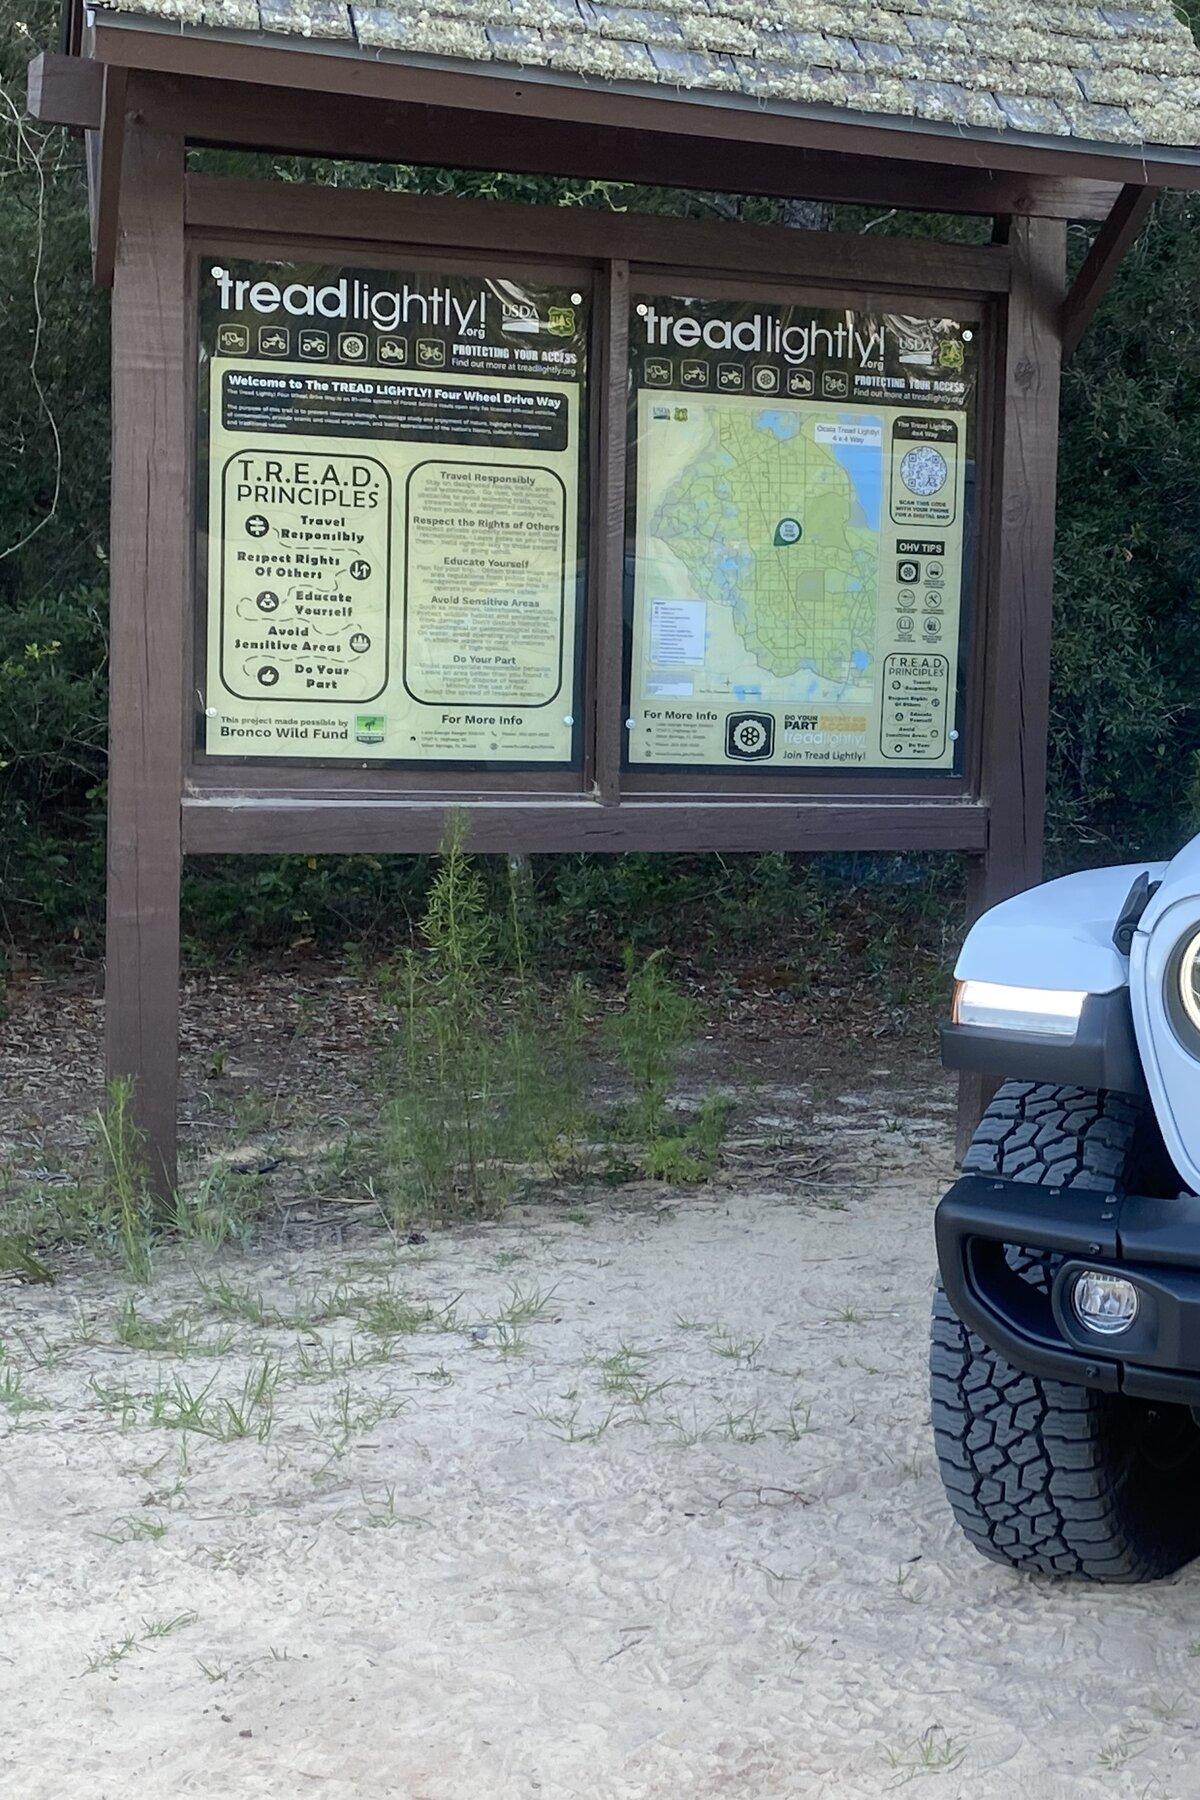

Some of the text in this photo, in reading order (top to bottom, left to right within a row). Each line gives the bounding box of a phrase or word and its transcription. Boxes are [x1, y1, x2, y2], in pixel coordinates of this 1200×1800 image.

[502, 304, 539, 318] USDA
[453, 344, 577, 364] PROTECTING YOUR ACCESS
[452, 358, 470, 367] Find
[471, 360, 485, 368] out
[486, 362, 507, 370] more
[508, 363, 516, 371] at
[854, 375, 965, 393] PROTECTING YOUR ACCESS
[228, 375, 561, 409] Welcome to The TREAD LIGHTLY! Four Wheel Drive Way
[853, 387, 869, 396] Find
[870, 389, 882, 397] out
[884, 391, 902, 399] more
[903, 392, 911, 400] at
[238, 459, 380, 488] T.R.E.A.D.
[440, 471, 536, 486] Travel Responsibly
[237, 484, 379, 509] PRINCIPLES
[300, 515, 346, 527] Travel
[413, 516, 560, 532] Respect the Rights of Others
[281, 528, 365, 544] Responsibly
[899, 543, 942, 553] OHV TIPS
[237, 551, 340, 567] Respect Rights
[443, 557, 529, 569] Educate Yourself
[255, 566, 322, 580] Of Others
[296, 590, 352, 603] Educate
[431, 595, 540, 608] Avoid Sensitive Areas
[295, 605, 353, 617] Yourself
[267, 626, 309, 637] Avoid
[235, 639, 341, 653] Sensitive Areas
[453, 654, 517, 665] Do Your Part
[295, 664, 350, 676] Do Your
[889, 668, 944, 677] PRINCIPLES
[306, 679, 338, 689] Part
[221, 716, 239, 724] This
[241, 717, 272, 726] project
[300, 719, 336, 727] possible
[338, 720, 348, 728] by
[441, 714, 523, 725] For More Info
[644, 710, 718, 721] For More Info
[784, 721, 818, 730] PART
[221, 726, 348, 740] Bronco Wild Fund
[783, 751, 866, 761] Join Tread Lightly!
